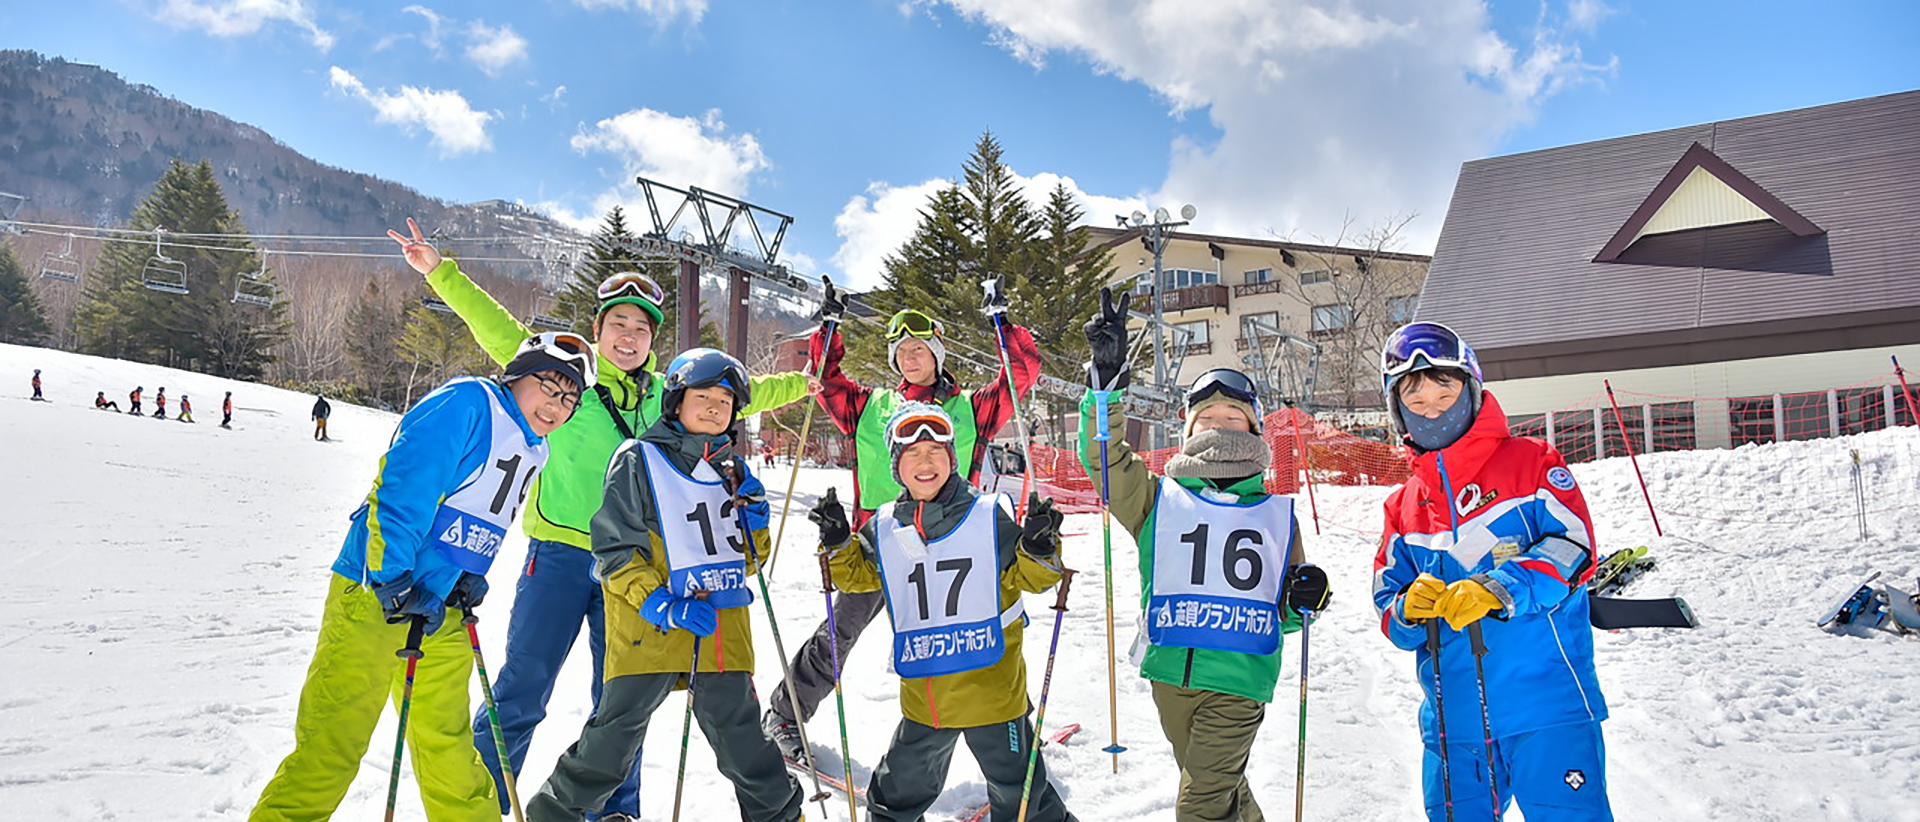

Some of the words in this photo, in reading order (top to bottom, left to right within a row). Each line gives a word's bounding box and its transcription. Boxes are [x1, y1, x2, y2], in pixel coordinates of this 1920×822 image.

[686, 499, 745, 555] 13
[1180, 523, 1263, 591] 16
[908, 557, 972, 621] 17
[914, 625, 997, 660] 志賀グランドホテル
[1174, 600, 1274, 636] 志賀グランドホテル
